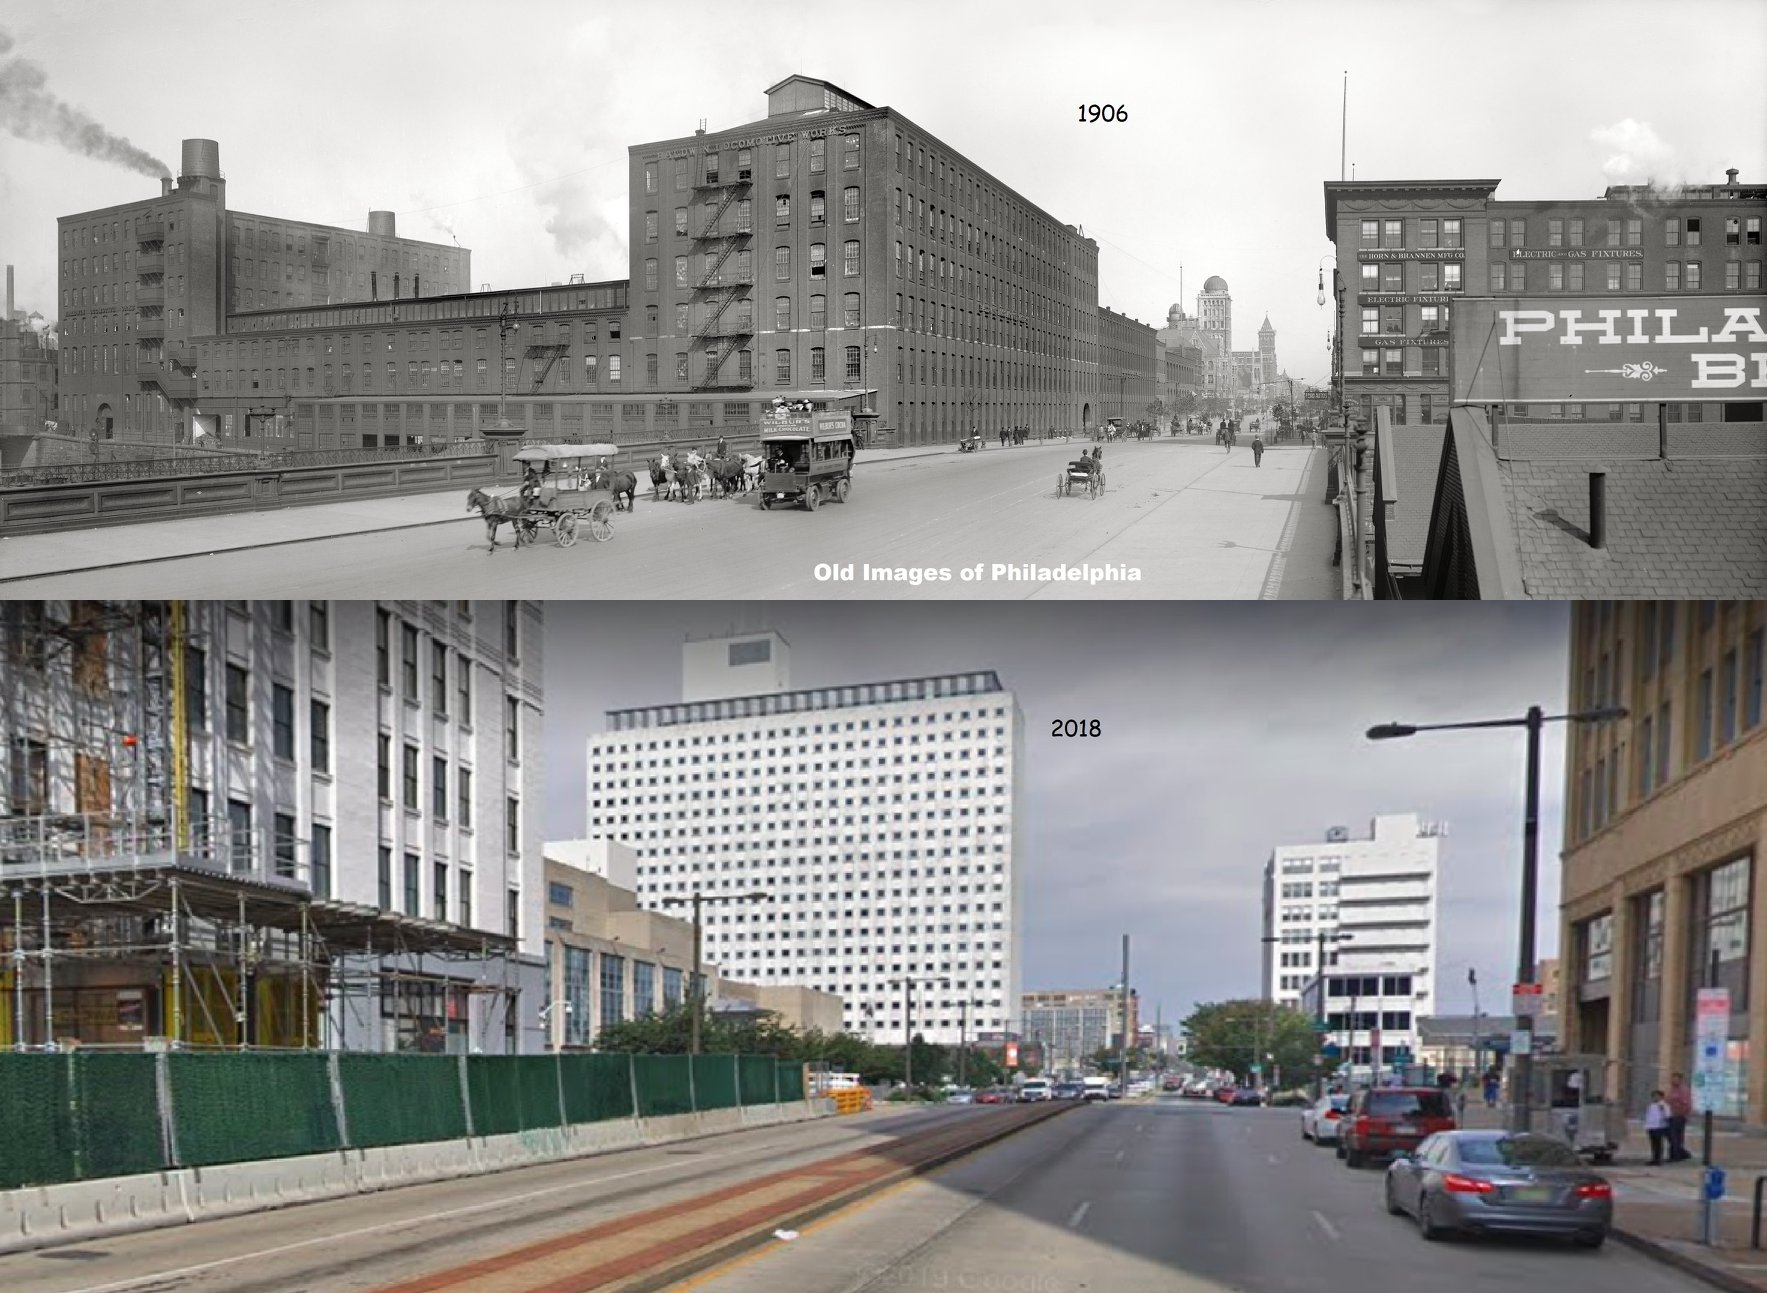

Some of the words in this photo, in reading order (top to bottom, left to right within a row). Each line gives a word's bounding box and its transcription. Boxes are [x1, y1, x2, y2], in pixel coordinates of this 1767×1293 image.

[657, 145, 715, 159] BALDWN
[801, 125, 846, 140] WORKS
[1568, 250, 1587, 258] GAS
[1691, 352, 1767, 388] B
